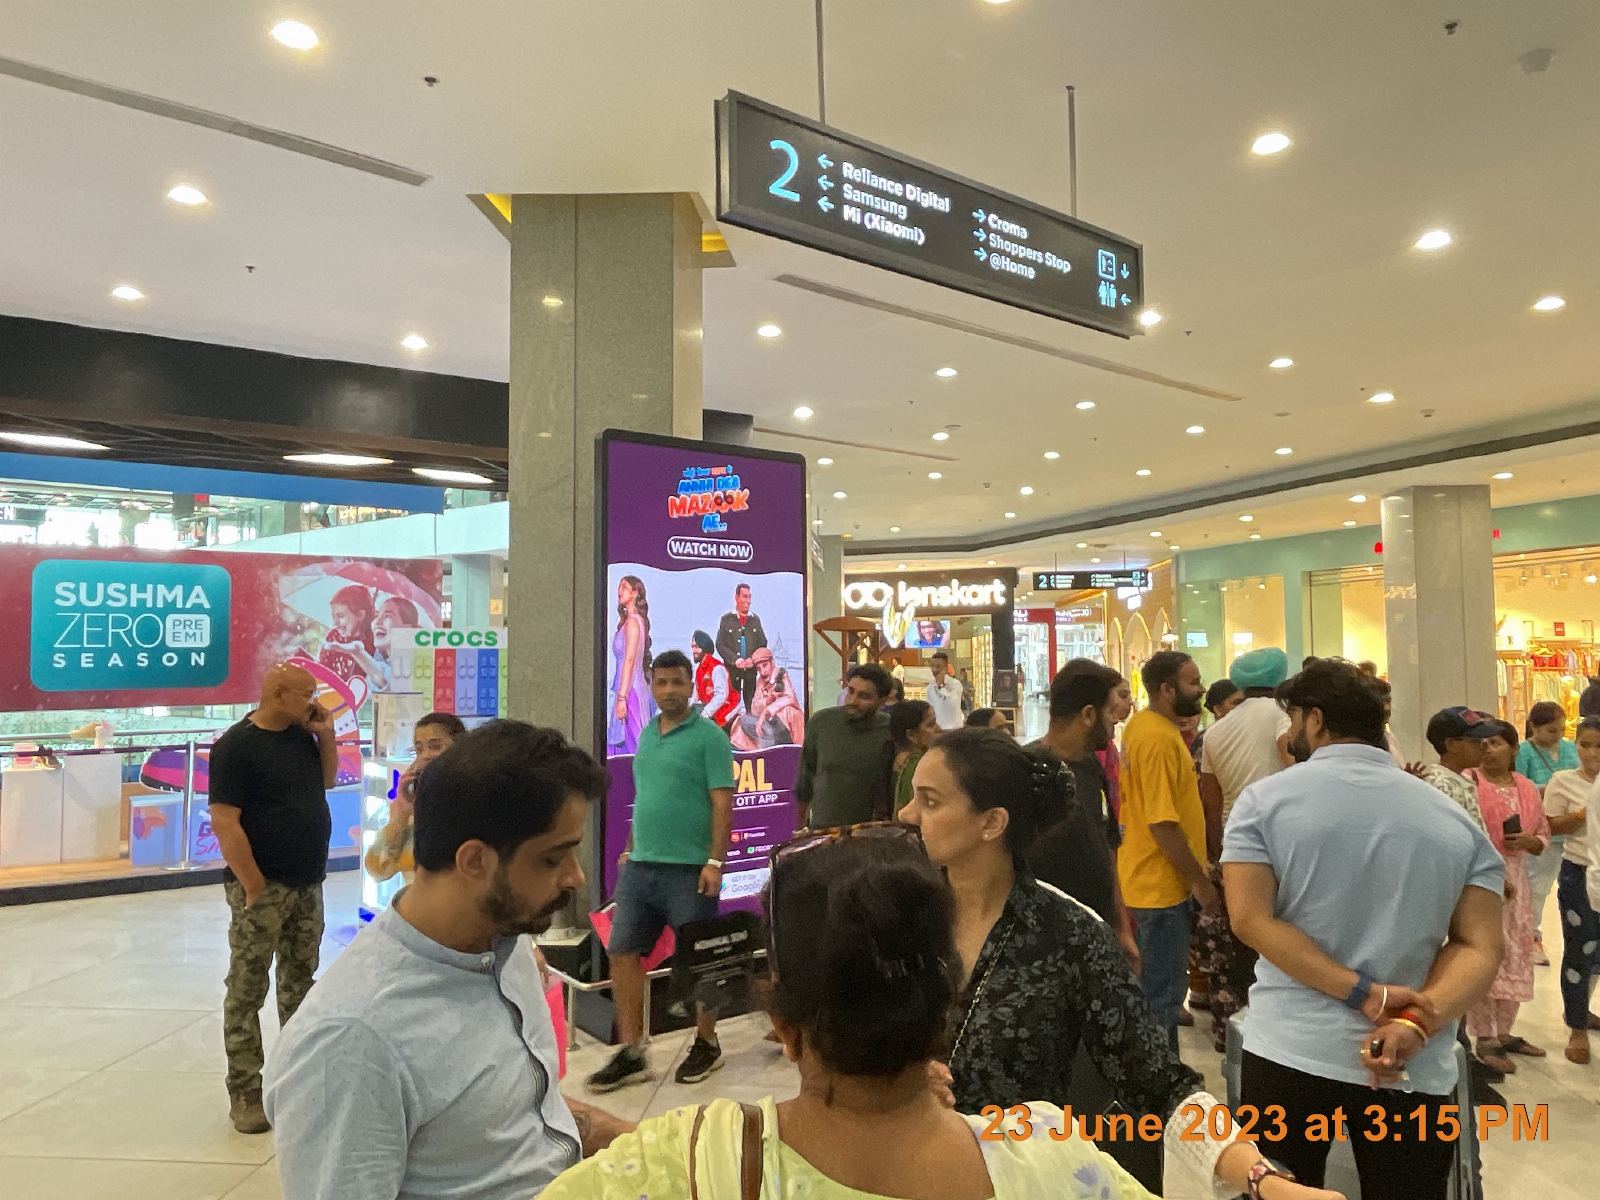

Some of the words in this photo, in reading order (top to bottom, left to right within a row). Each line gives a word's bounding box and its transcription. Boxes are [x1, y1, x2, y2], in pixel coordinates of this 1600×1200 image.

[769, 139, 800, 202] 2
[843, 161, 904, 196] Reliance
[905, 184, 951, 213] Digital
[843, 183, 908, 220] Samsung
[843, 205, 861, 224] Mi
[864, 211, 926, 246] (Xiaomi)
[988, 213, 1028, 239] Croma
[989, 233, 1043, 263] Shoppers
[1045, 251, 1071, 274] Stop
[989, 253, 1035, 279] @Home
[671, 540, 717, 556] WATCH
[720, 545, 750, 557] NOW
[54, 581, 211, 609] SUSHMA
[898, 579, 1006, 607] lenskart
[53, 613, 164, 648] ZERO
[172, 619, 204, 630] PRE
[172, 631, 204, 643] EMI
[415, 631, 498, 647] crocs
[52, 652, 205, 668] SEASON
[736, 796, 756, 807] OTT
[758, 794, 778, 805] APP
